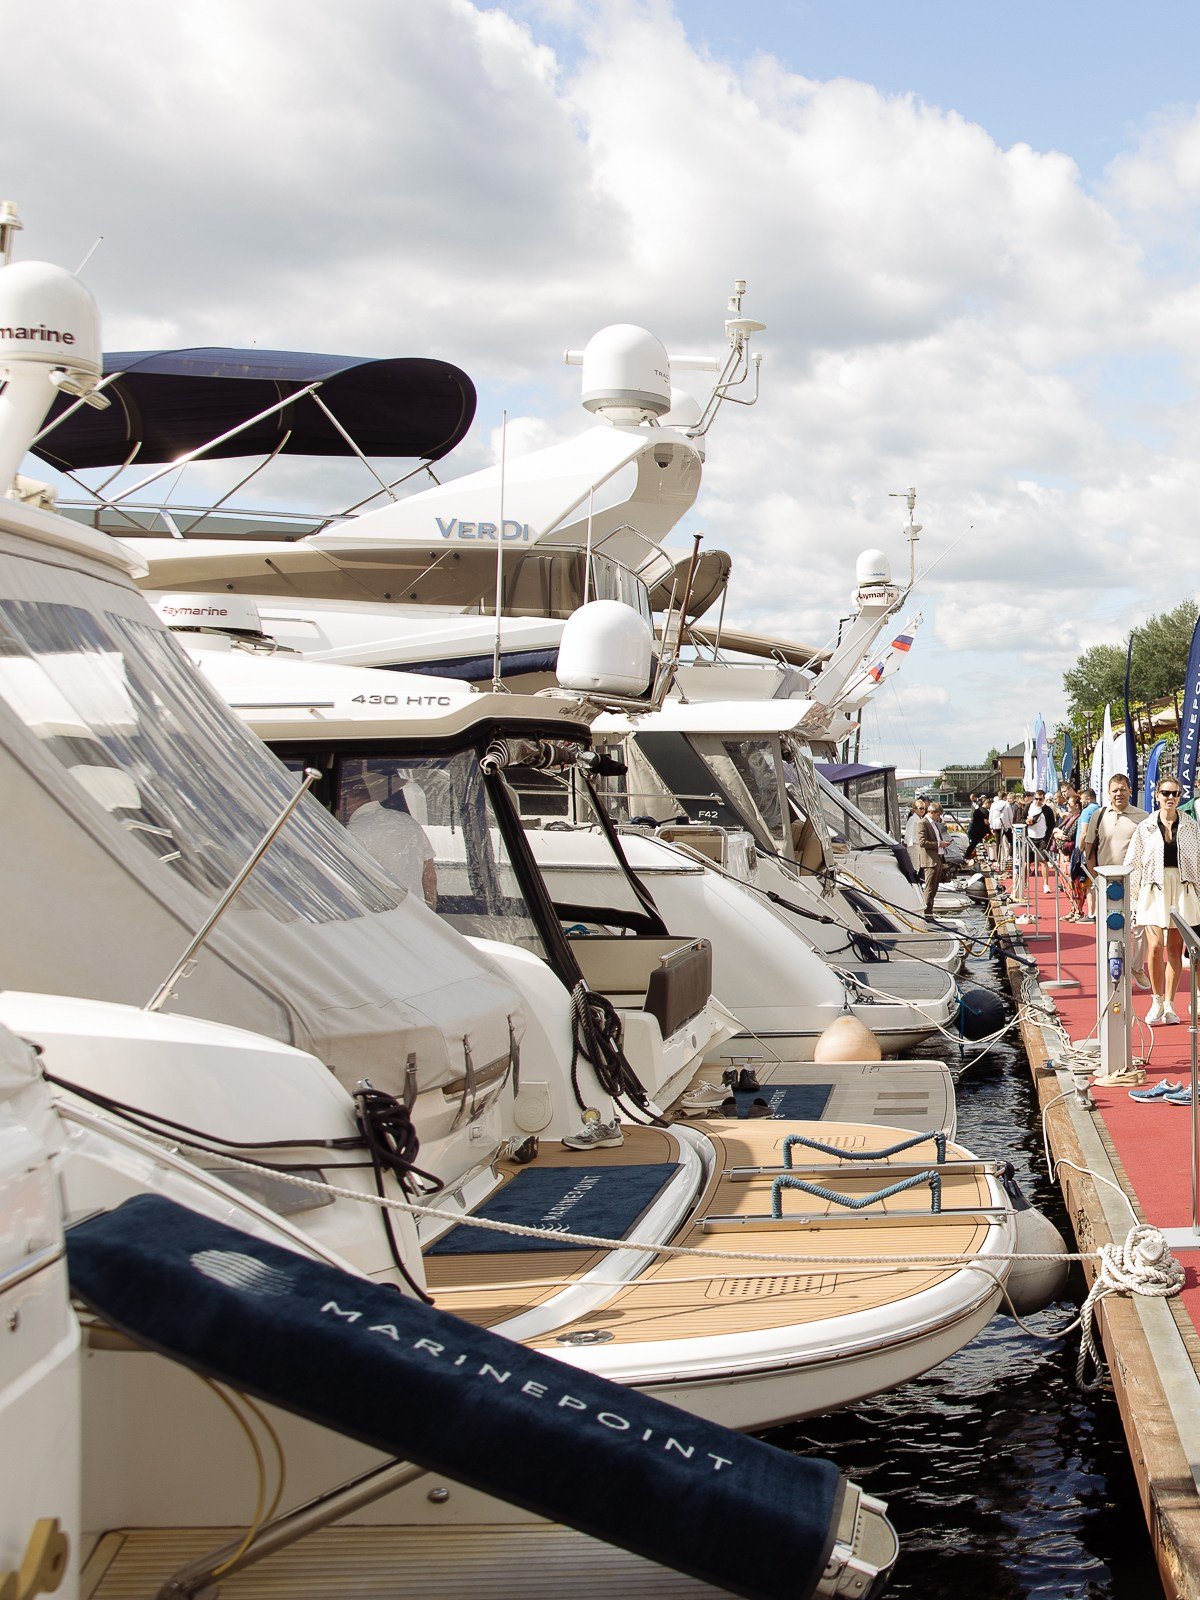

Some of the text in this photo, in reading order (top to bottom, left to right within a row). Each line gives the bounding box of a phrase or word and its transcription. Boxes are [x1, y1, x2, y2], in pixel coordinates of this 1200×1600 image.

[351, 694, 451, 706] 430 HTC
[698, 810, 719, 819] F42
[540, 1175, 603, 1221] MARINEPOINT
[320, 1301, 732, 1470] MARINEPOINT
